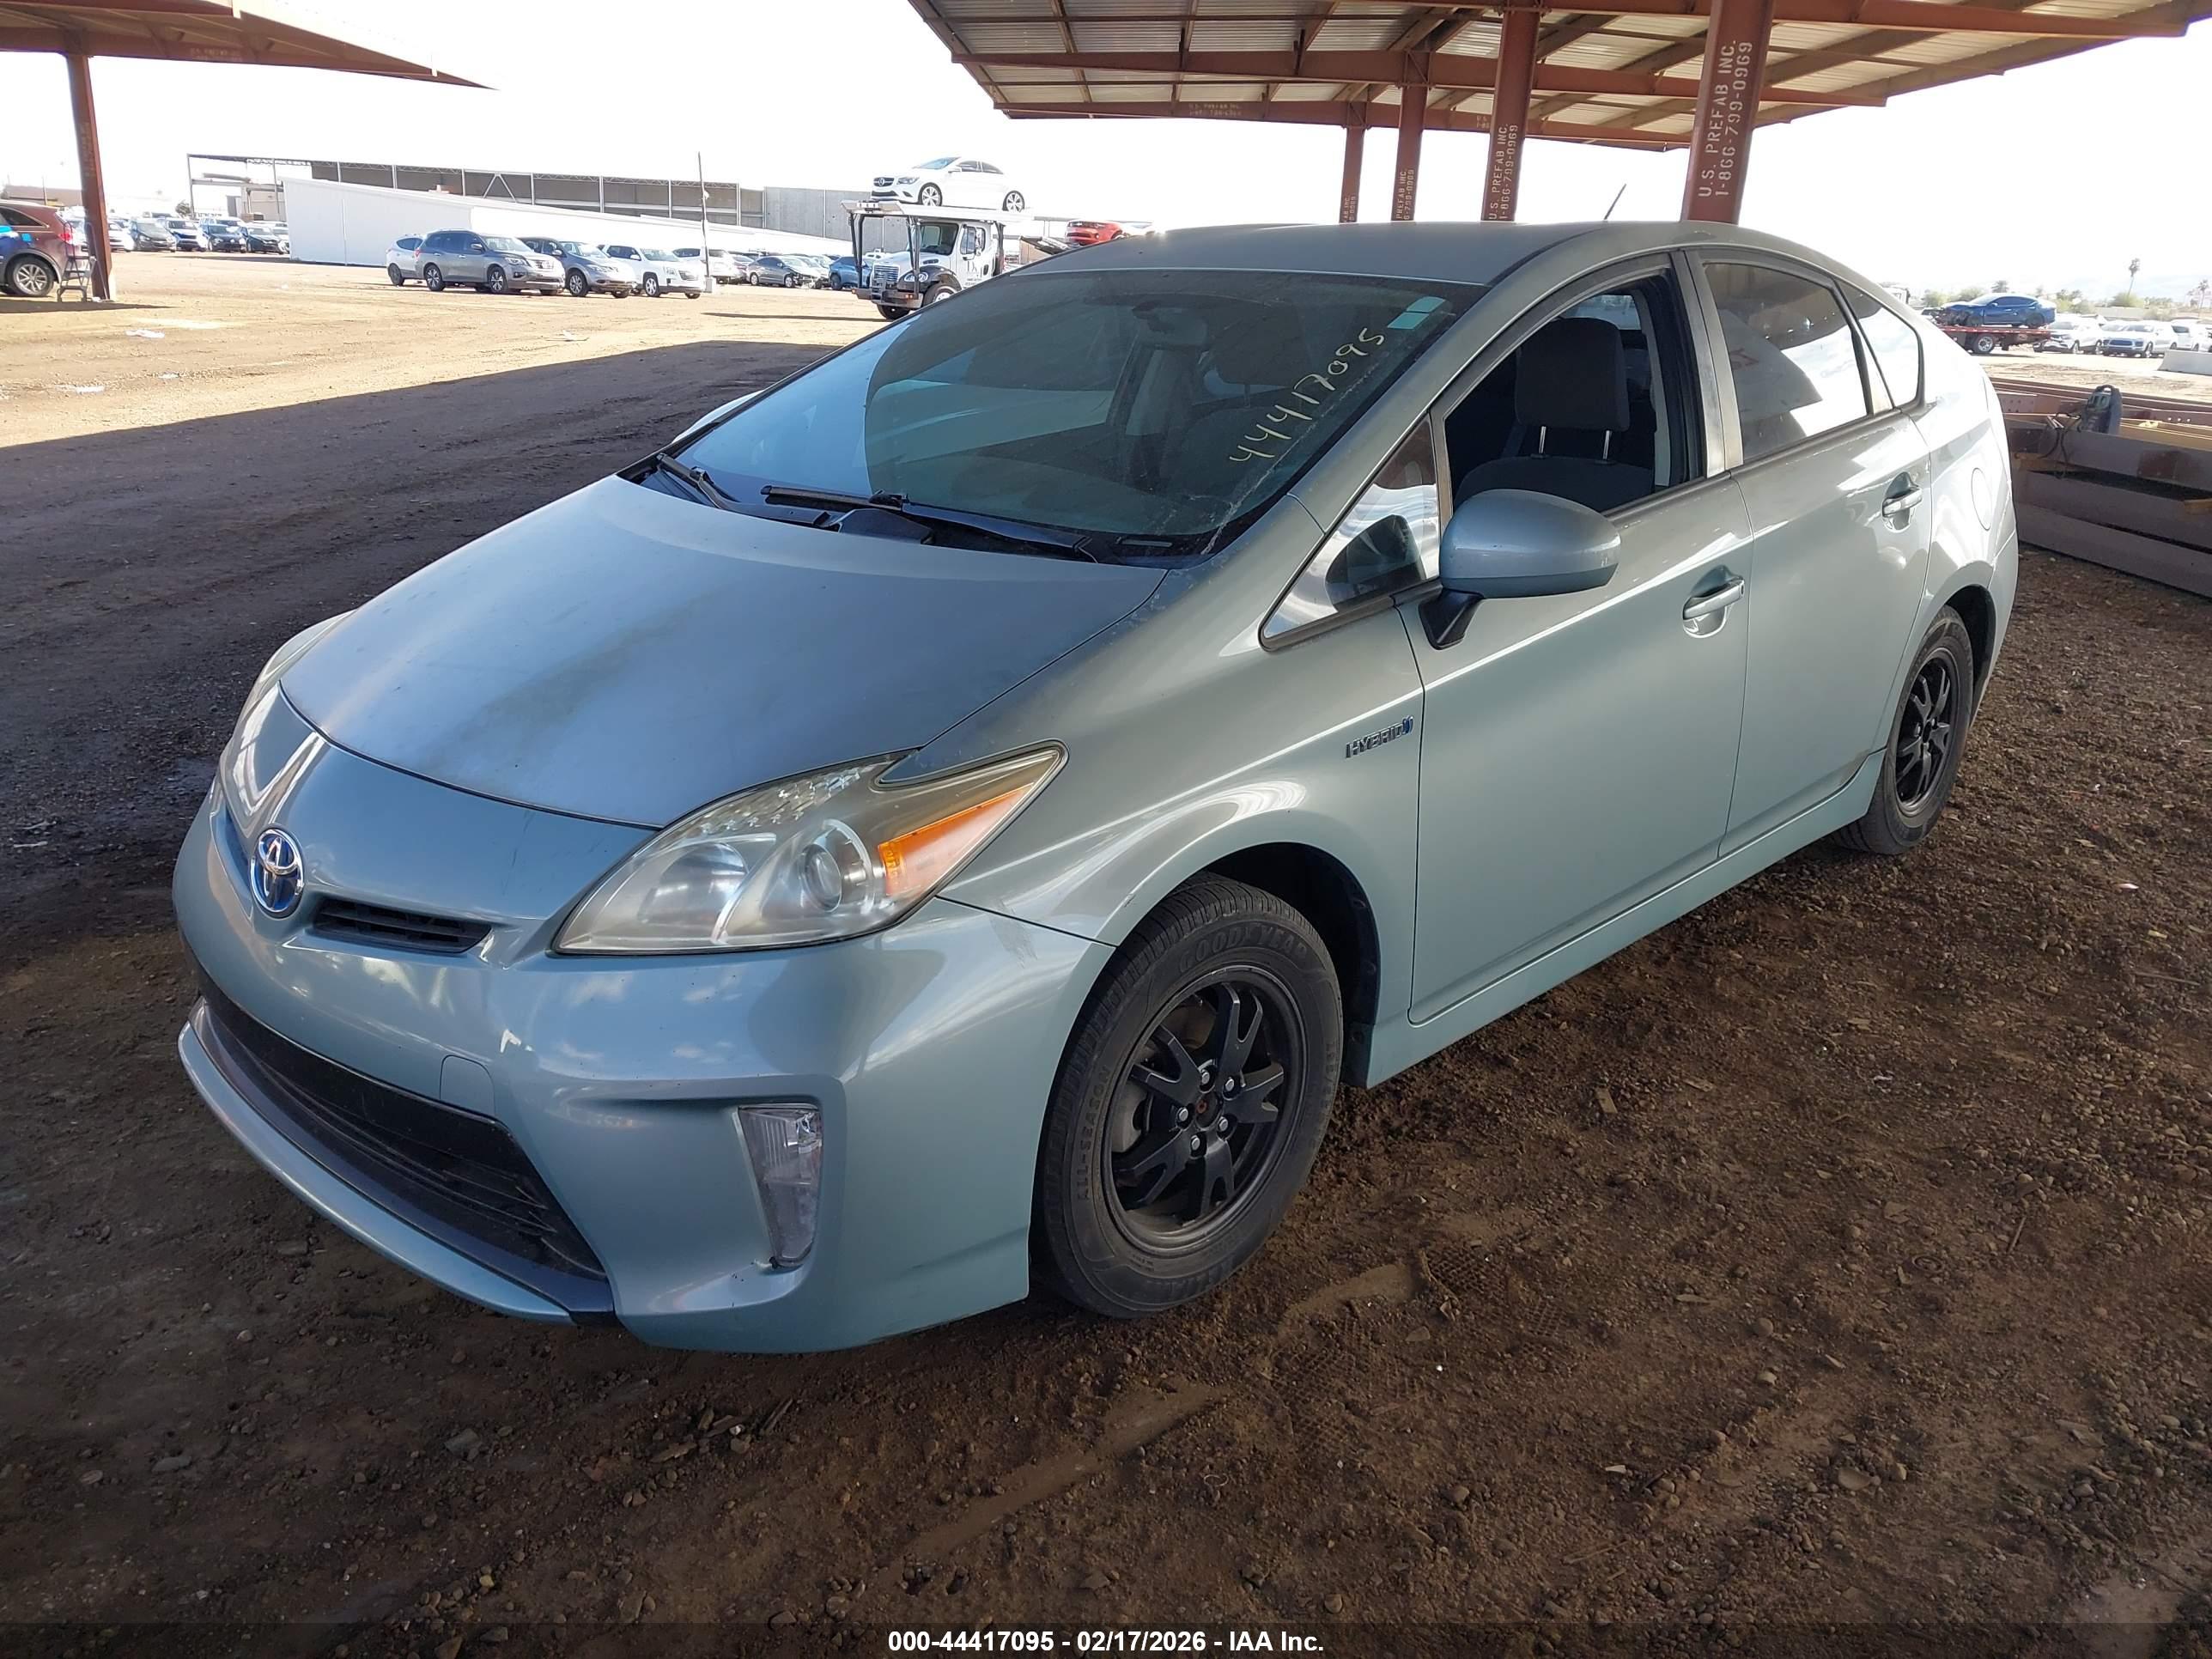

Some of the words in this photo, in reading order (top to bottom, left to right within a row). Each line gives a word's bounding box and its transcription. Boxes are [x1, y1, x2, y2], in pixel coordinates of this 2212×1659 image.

[1717, 40, 1737, 74] INC.
[1497, 124, 1509, 144] INC.
[1705, 83, 1729, 153] PREFAB
[1715, 41, 1753, 196] 1-866-799-0969
[1492, 150, 1505, 193] PREFAB
[1698, 164, 1717, 198] U.S.
[1229, 326, 1385, 463] 44417095
[1345, 721, 1404, 759] HYBRID
[1180, 921, 1308, 974] GOODYEAR
[1077, 1066, 1111, 1200] ALL-SEASON
